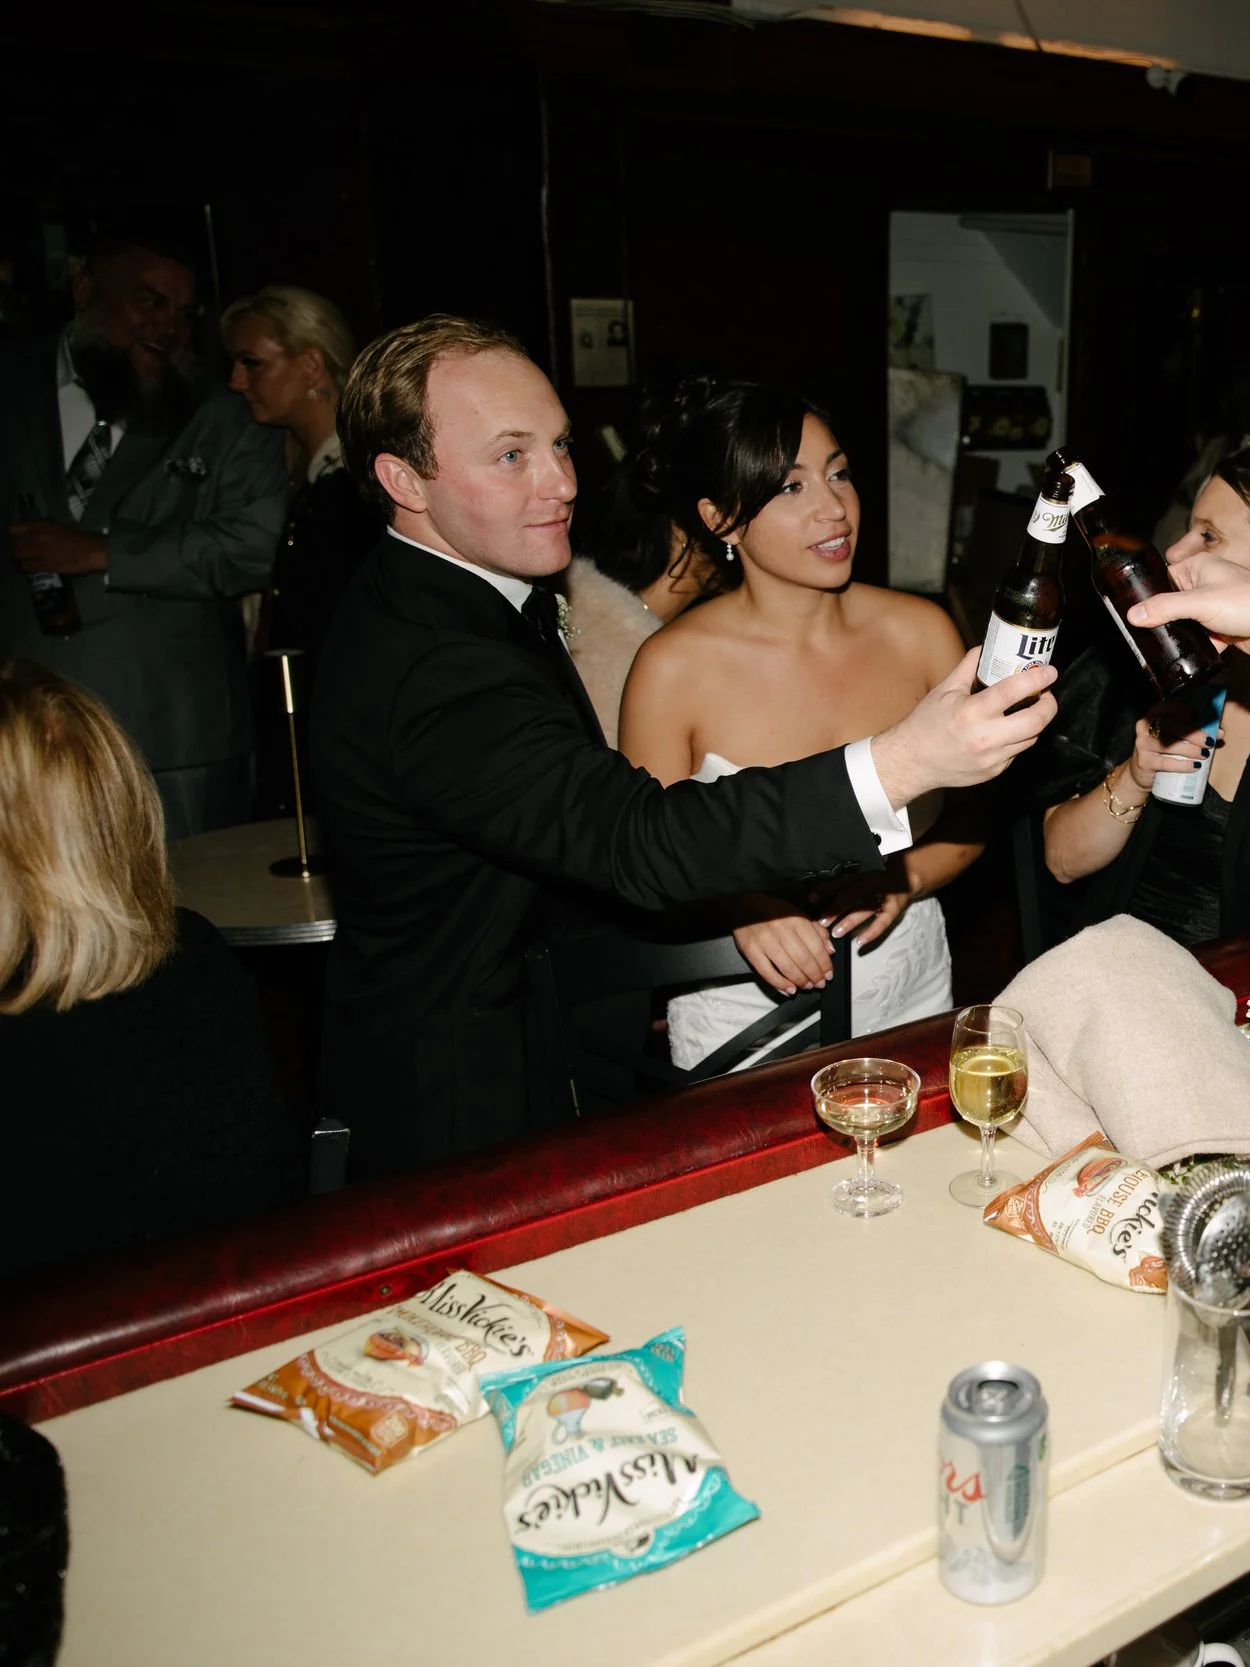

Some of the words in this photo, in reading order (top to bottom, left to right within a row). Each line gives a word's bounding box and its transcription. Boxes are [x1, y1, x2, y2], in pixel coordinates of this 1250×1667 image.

[1087, 1207, 1115, 1235] BBQ
[1110, 1192, 1158, 1259] ickie's
[459, 1294, 532, 1358] Vickie's
[515, 1472, 639, 1534] Vickie's
